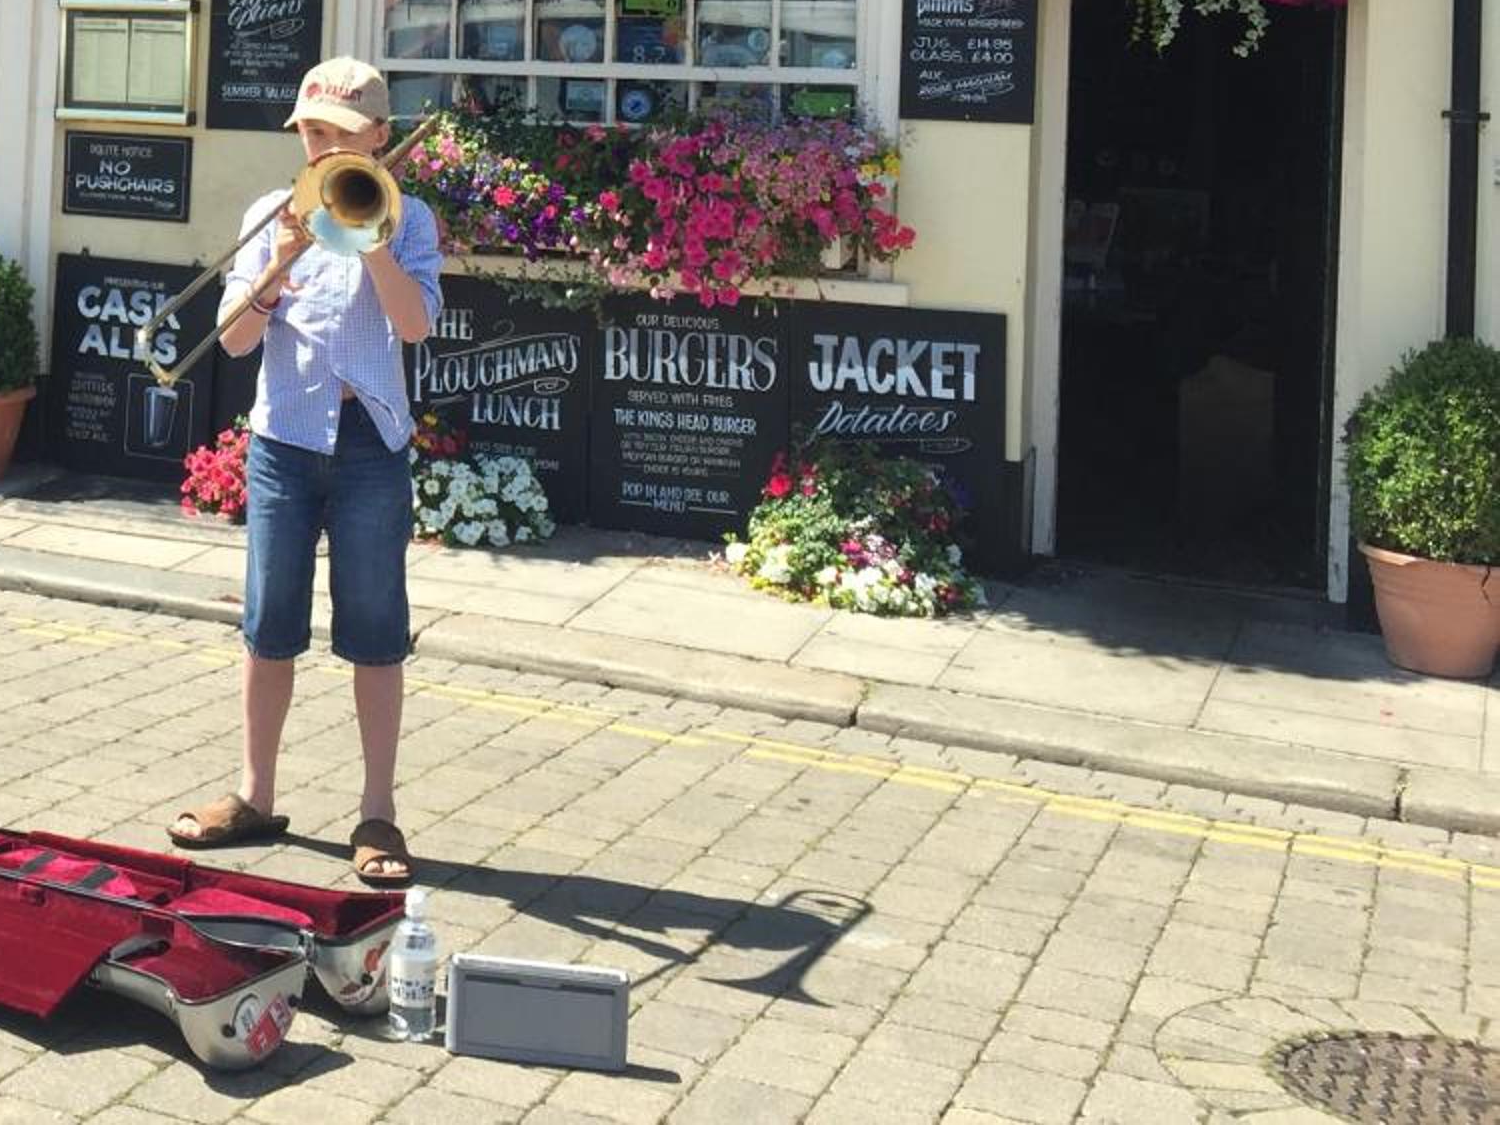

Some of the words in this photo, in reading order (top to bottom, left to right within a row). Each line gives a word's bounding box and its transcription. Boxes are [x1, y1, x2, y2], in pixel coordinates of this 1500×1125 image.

[99, 159, 132, 176] NO
[75, 173, 176, 195] PUSHCHAIRS
[76, 284, 182, 332] CASK
[635, 314, 659, 327] OUR
[662, 315, 721, 330] DELICIOUS
[602, 325, 779, 393] BURGERS
[808, 333, 981, 402] JACKET
[470, 393, 561, 431] LUNCH
[627, 389, 669, 405] SERVED
[671, 392, 699, 407] WITH
[703, 393, 734, 409] FRIES
[613, 407, 636, 427] THE
[637, 409, 674, 430] KINGS
[677, 412, 709, 432] HEAD
[712, 415, 757, 435] BURGER
[805, 399, 957, 445] Potatoes
[621, 481, 643, 497] POP
[707, 489, 730, 505] OUR
[653, 499, 685, 513] MENU
